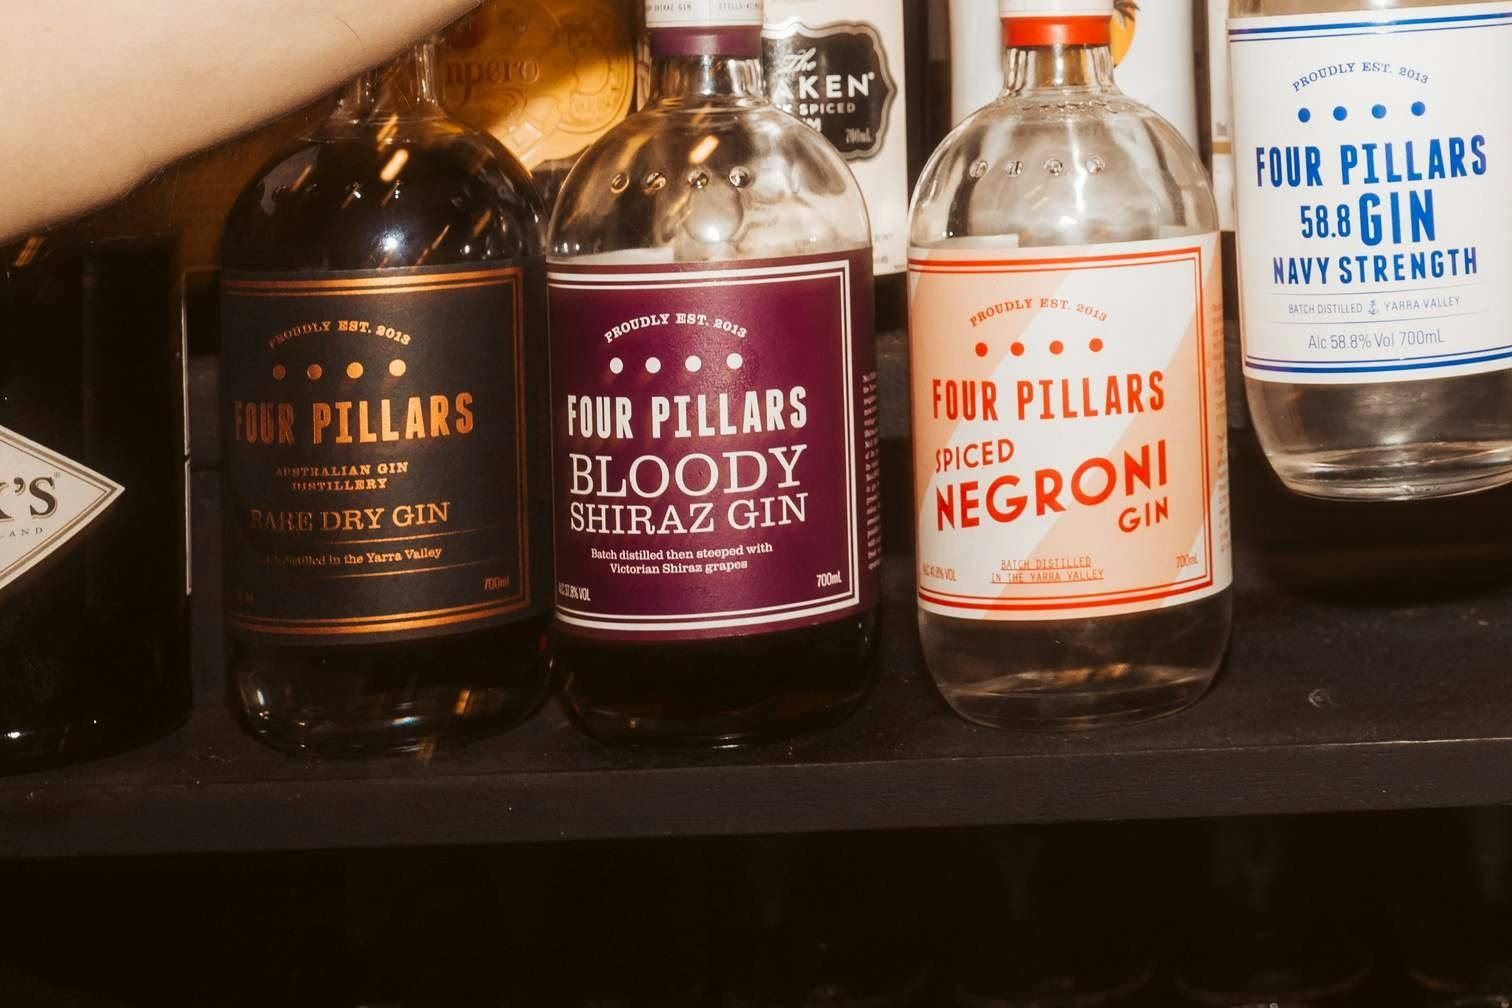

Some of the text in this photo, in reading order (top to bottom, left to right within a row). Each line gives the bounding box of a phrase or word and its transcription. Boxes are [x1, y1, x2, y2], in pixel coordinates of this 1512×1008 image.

[1292, 61, 1430, 93] PROUDLY EST. 2013
[799, 102, 857, 116] SPICED
[1256, 134, 1488, 188] FOUR PILLARS
[1299, 188, 1437, 247] 58.8 GIN
[1272, 246, 1478, 286] NAVY STRENGTH
[968, 297, 1109, 328] PROUDLY EST. 2013
[1287, 295, 1461, 315] BATCH DISTILLED YARRA VALLEY
[268, 320, 412, 350] PROUDLY EST. 2013
[603, 311, 749, 344] PROUDLY EST. 2013
[1307, 329, 1445, 351] Alc 58.8% Vol 700mL
[931, 369, 1166, 422] FOUR PILLARS
[234, 392, 475, 445] FOUR PILLARS
[567, 385, 808, 440] FOUR PILLARS
[275, 461, 409, 478] AUSTRALIAN GIN
[568, 443, 808, 498] BLOODY
[935, 437, 1015, 474] SPICED
[291, 477, 389, 492] DISTILLERY
[935, 439, 1168, 532] NEGRONI
[250, 501, 452, 533] RARE DRY GIN
[569, 491, 810, 536] SHIRAZ GIN
[1117, 496, 1170, 534] GIN
[343, 554, 364, 565] the
[366, 550, 403, 565] Yarra
[404, 546, 443, 561] Valley
[591, 542, 774, 561] Batch distilled then steeped with
[609, 559, 748, 575] Victorian Shiraz grapes
[1000, 555, 1092, 571] BATCH DISTILLED
[815, 569, 843, 588] 700mL
[1029, 569, 1063, 583] YARRA
[1066, 567, 1105, 582] VALLEY
[578, 585, 592, 602] VOL
